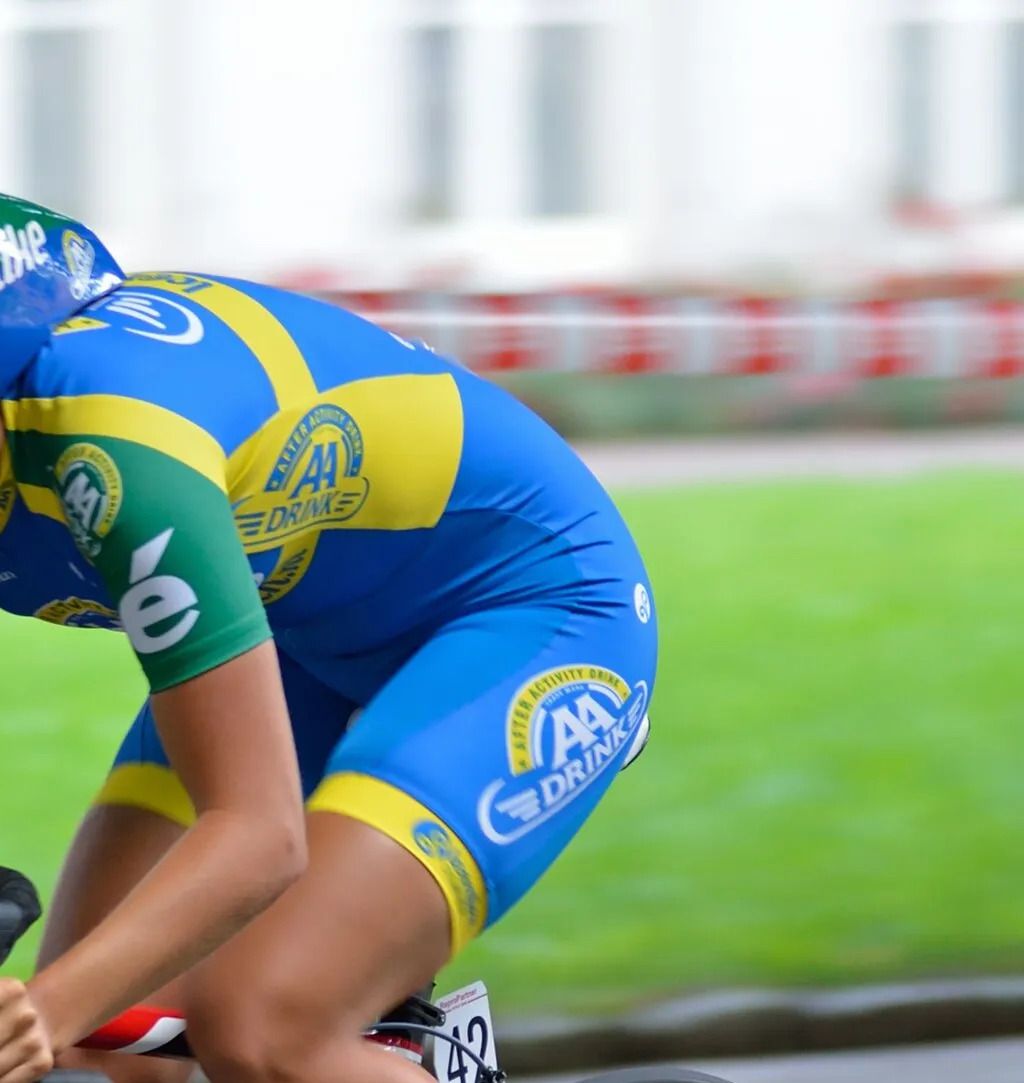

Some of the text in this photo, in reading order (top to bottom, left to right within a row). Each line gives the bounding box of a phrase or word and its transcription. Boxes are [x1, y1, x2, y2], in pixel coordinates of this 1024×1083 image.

[289, 441, 339, 500] AA
[264, 491, 340, 534] DRINK
[119, 527, 201, 654] é
[511, 667, 621, 752] AFTER ACTIVITY DRINK
[550, 691, 618, 771] AA
[539, 714, 629, 808] DRINK
